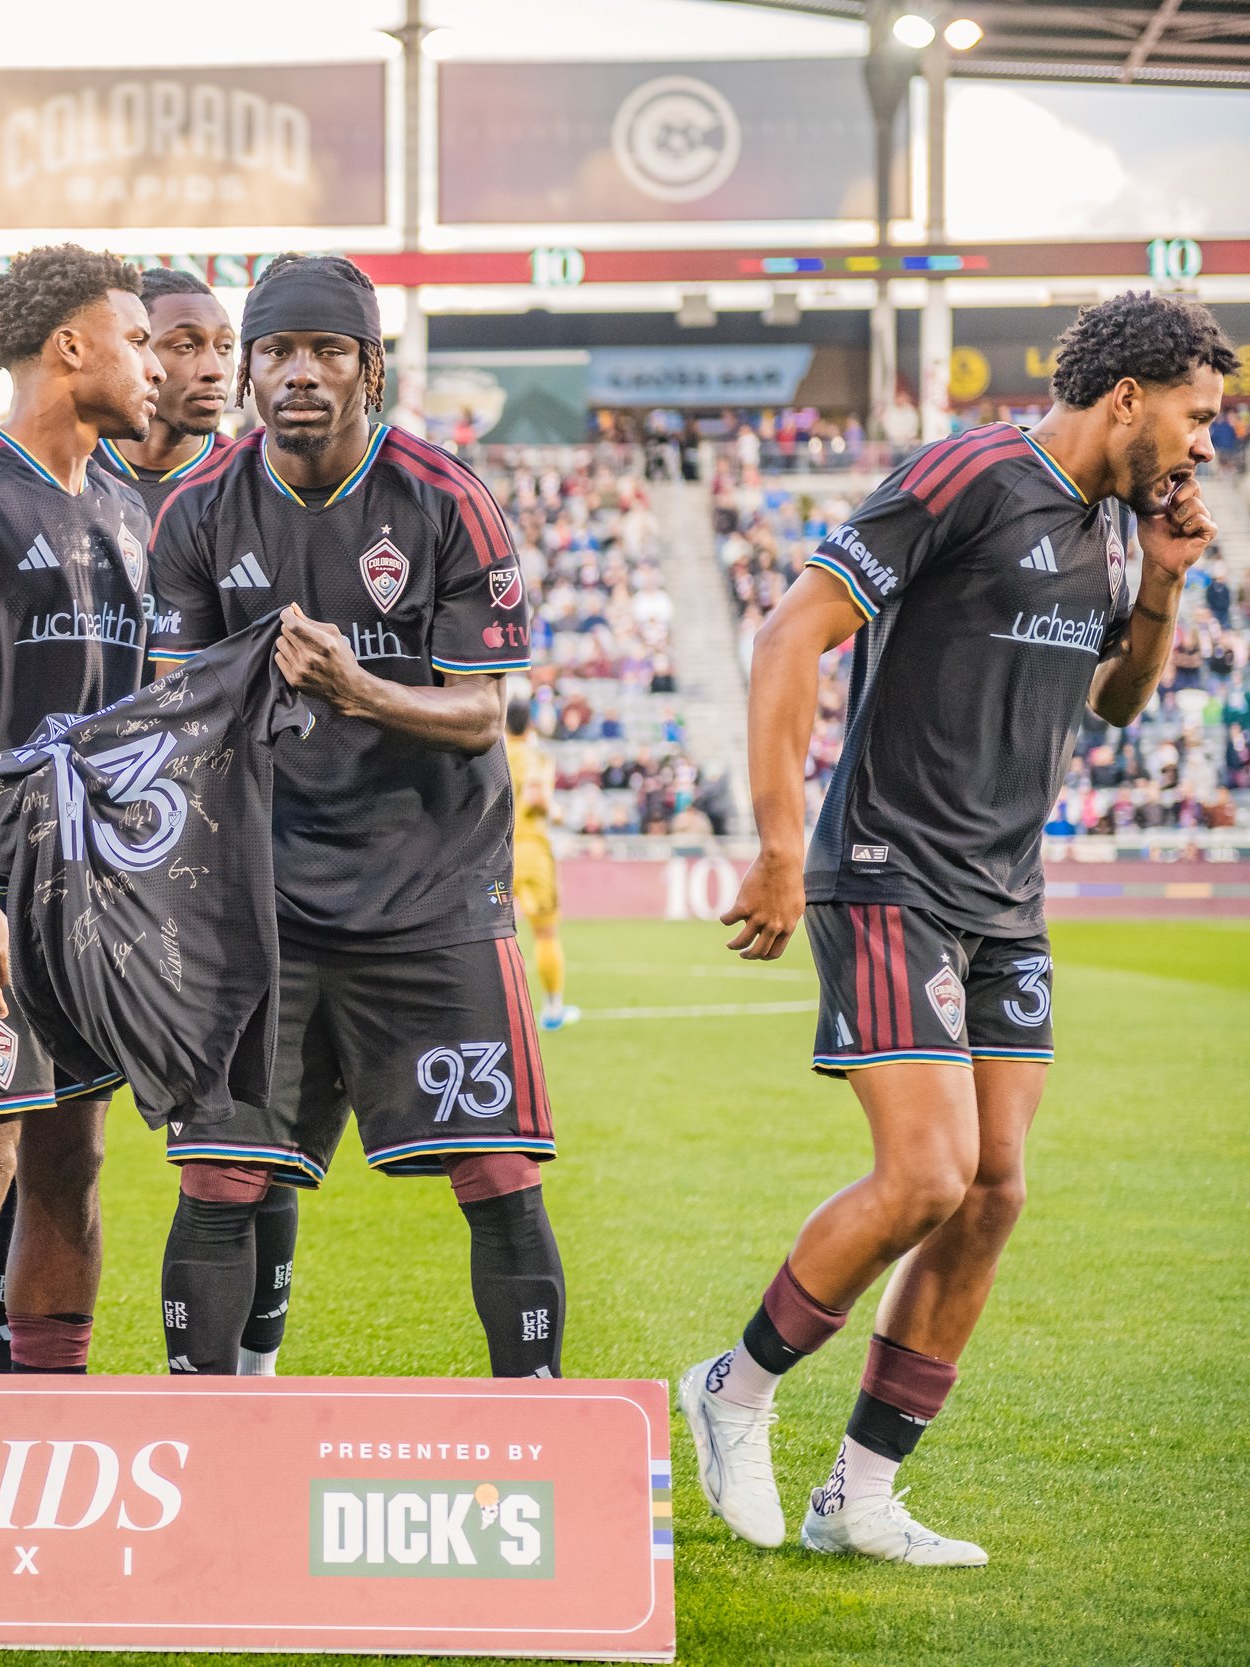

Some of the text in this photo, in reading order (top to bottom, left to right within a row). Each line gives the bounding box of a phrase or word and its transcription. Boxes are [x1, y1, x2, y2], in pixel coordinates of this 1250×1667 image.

[530, 246, 585, 286] 10
[1146, 238, 1203, 281] 10
[369, 557, 402, 570] COLORADO
[492, 572, 512, 582] MLS
[827, 524, 899, 597] Kiewit
[31, 600, 137, 646] uchealth
[1011, 602, 1105, 656] uchealth
[38, 730, 188, 872] 13
[662, 856, 739, 921] 10
[1002, 955, 1054, 1028] 3
[417, 1041, 513, 1122] 93
[320, 1442, 543, 1461] PRESENTED BY
[322, 1490, 542, 1567] DICK'S
